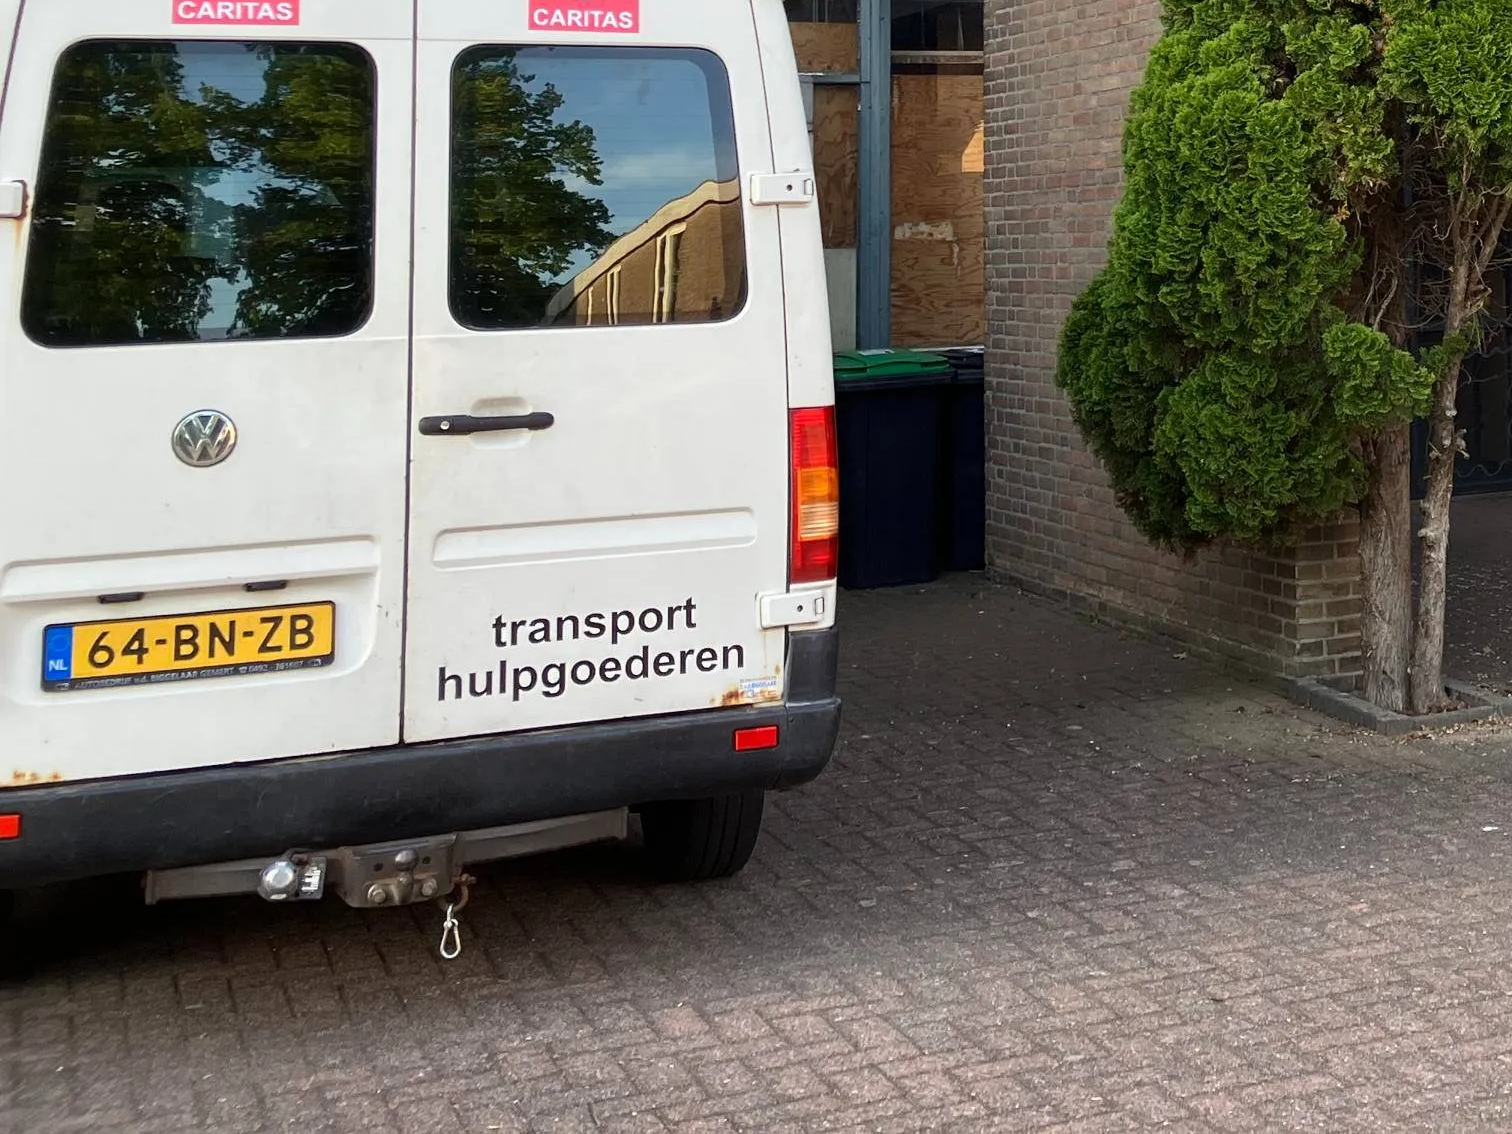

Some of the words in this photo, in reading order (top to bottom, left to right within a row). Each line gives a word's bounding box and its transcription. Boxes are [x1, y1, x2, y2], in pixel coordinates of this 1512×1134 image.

[177, 0, 293, 21] CARITAS
[533, 8, 633, 29] CARITAS
[492, 597, 697, 647] transport
[87, 614, 315, 669] 64-BN-ZB
[48, 659, 68, 672] NL
[438, 643, 744, 702] hulpgoederen
